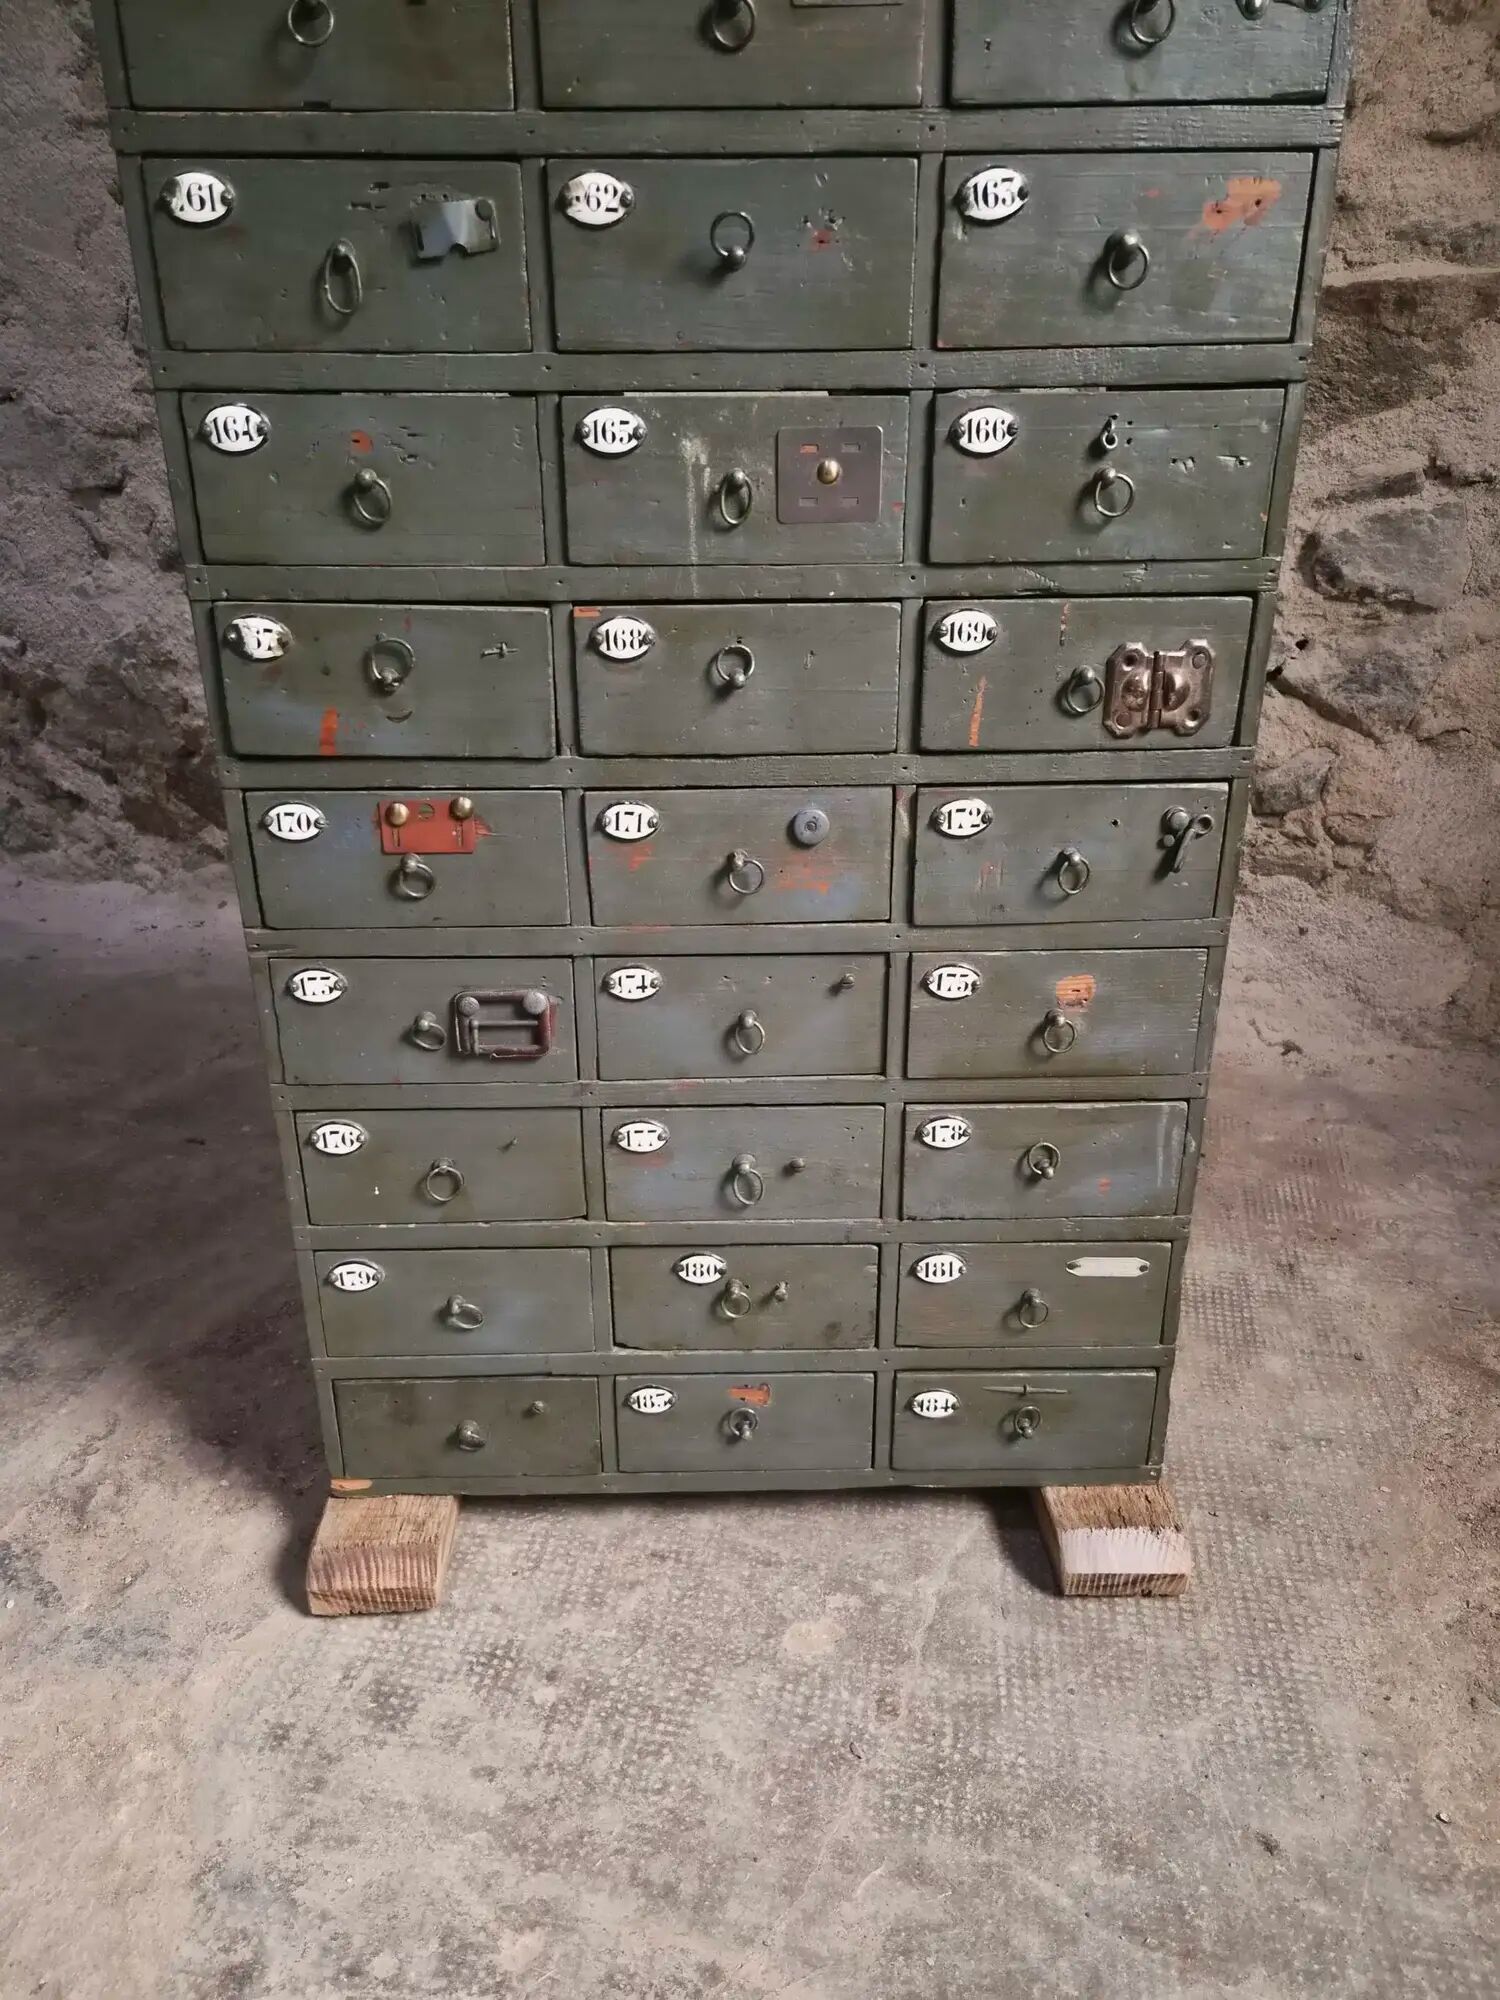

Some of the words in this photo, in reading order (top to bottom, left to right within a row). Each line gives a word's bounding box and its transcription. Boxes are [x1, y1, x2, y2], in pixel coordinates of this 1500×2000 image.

[179, 182, 217, 212] 61
[575, 183, 619, 212] 62
[971, 177, 1015, 210] 163
[211, 415, 254, 444] 164
[593, 420, 634, 445] 165
[967, 418, 1007, 444] 166
[605, 628, 643, 652] 168
[949, 620, 987, 644] 169
[275, 812, 312, 833] 170
[615, 811, 642, 833] 171
[947, 807, 982, 830] 172
[300, 976, 334, 996] 173
[617, 974, 648, 994] 174
[936, 973, 969, 992] 175
[322, 1130, 355, 1149] 176
[627, 1130, 658, 1148] 177
[930, 1125, 963, 1143] 178
[339, 1270, 372, 1286] 179
[684, 1262, 717, 1278] 180
[924, 1261, 954, 1278] 181
[918, 1397, 950, 1413] 184
